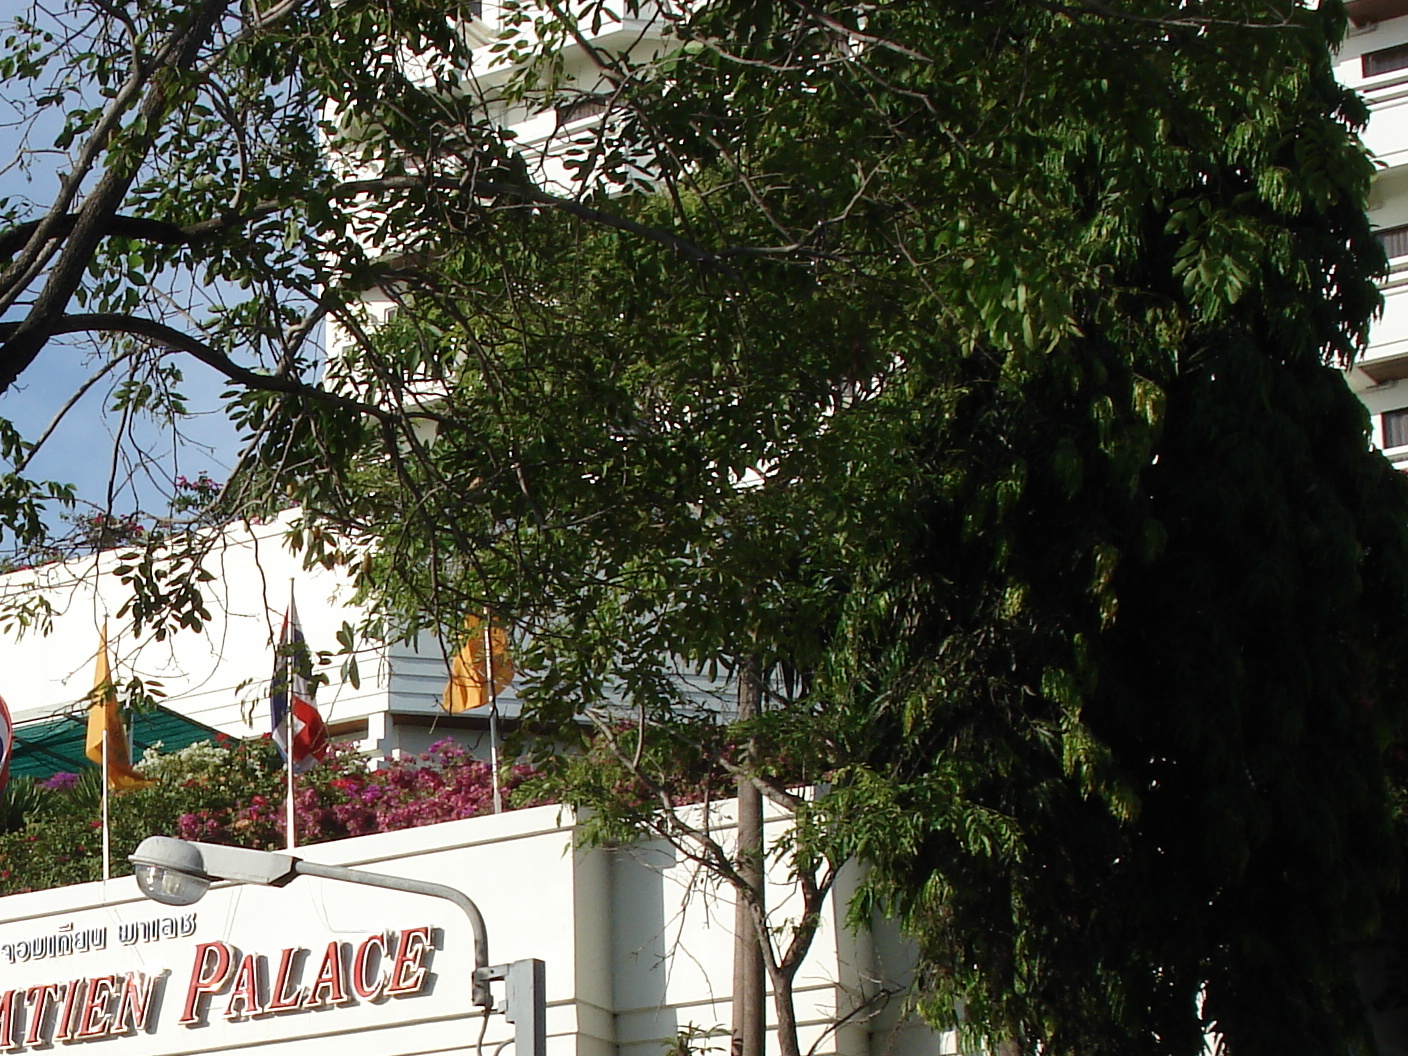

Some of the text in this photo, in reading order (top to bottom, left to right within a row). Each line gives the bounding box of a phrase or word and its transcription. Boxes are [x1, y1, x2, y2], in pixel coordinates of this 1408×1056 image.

[1, 922, 108, 964] จอมเทียน
[178, 925, 442, 1028] PALACE
